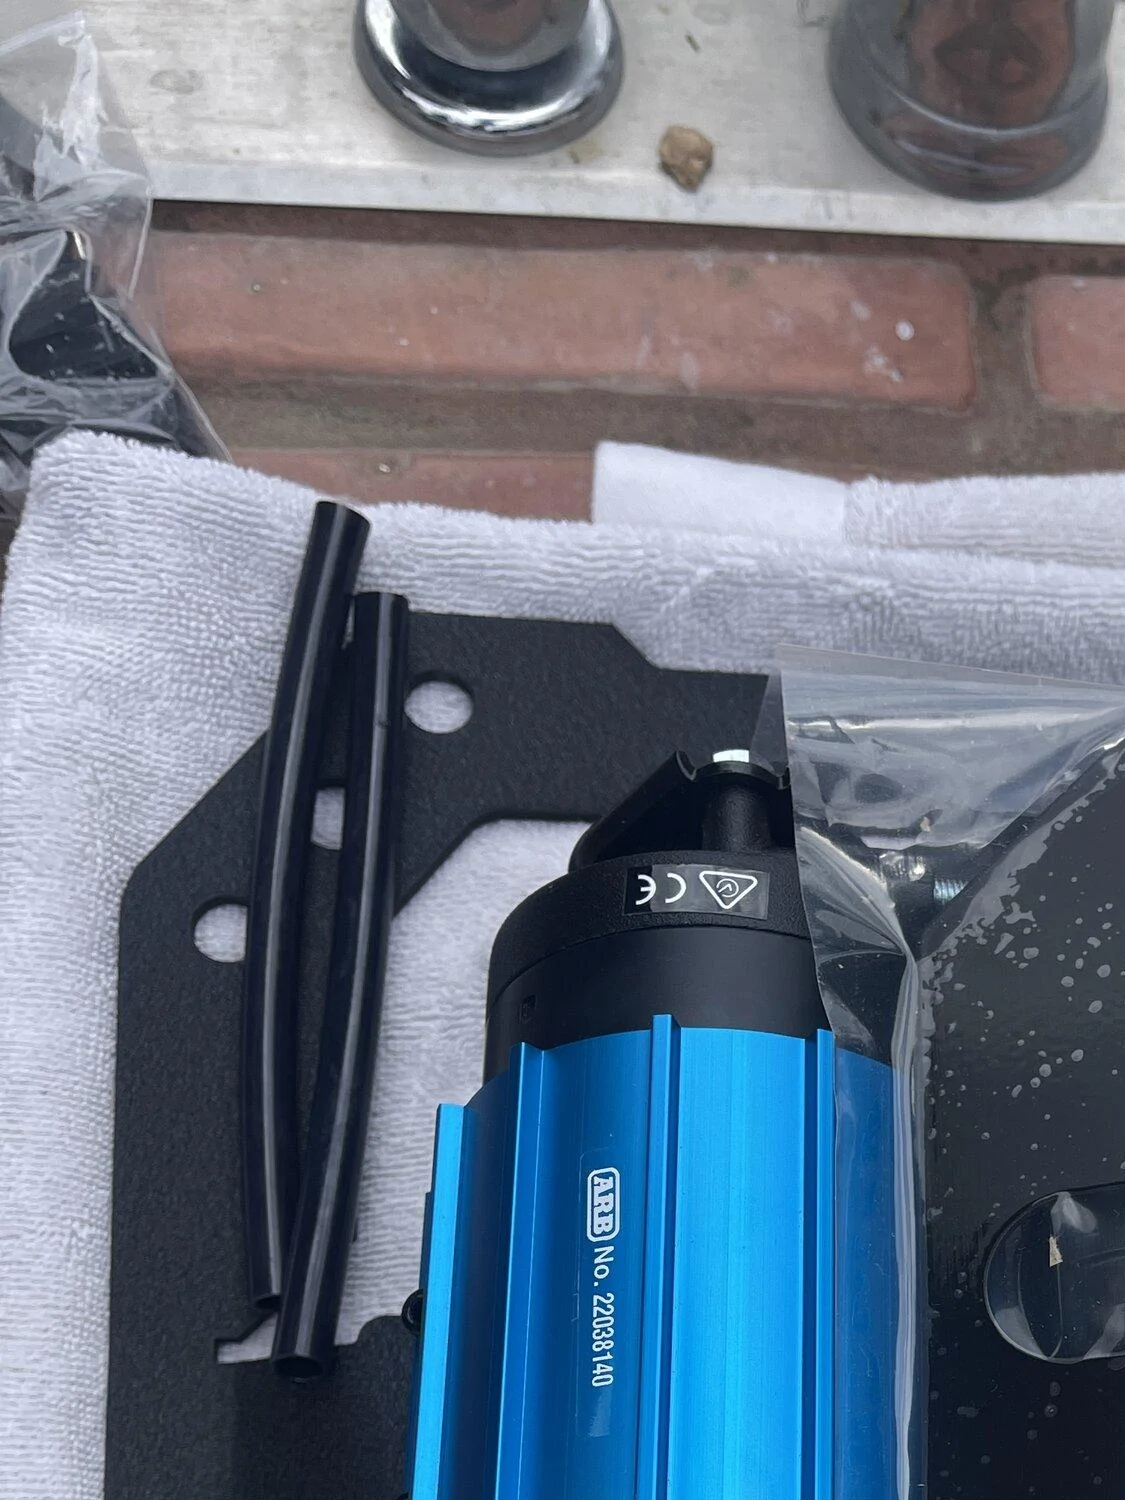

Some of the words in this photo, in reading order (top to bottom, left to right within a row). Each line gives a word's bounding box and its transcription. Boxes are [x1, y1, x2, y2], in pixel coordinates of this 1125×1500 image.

[593, 1176, 614, 1236] ARB
[593, 1245, 615, 1287] No.
[591, 1292, 615, 1387] 22038140
